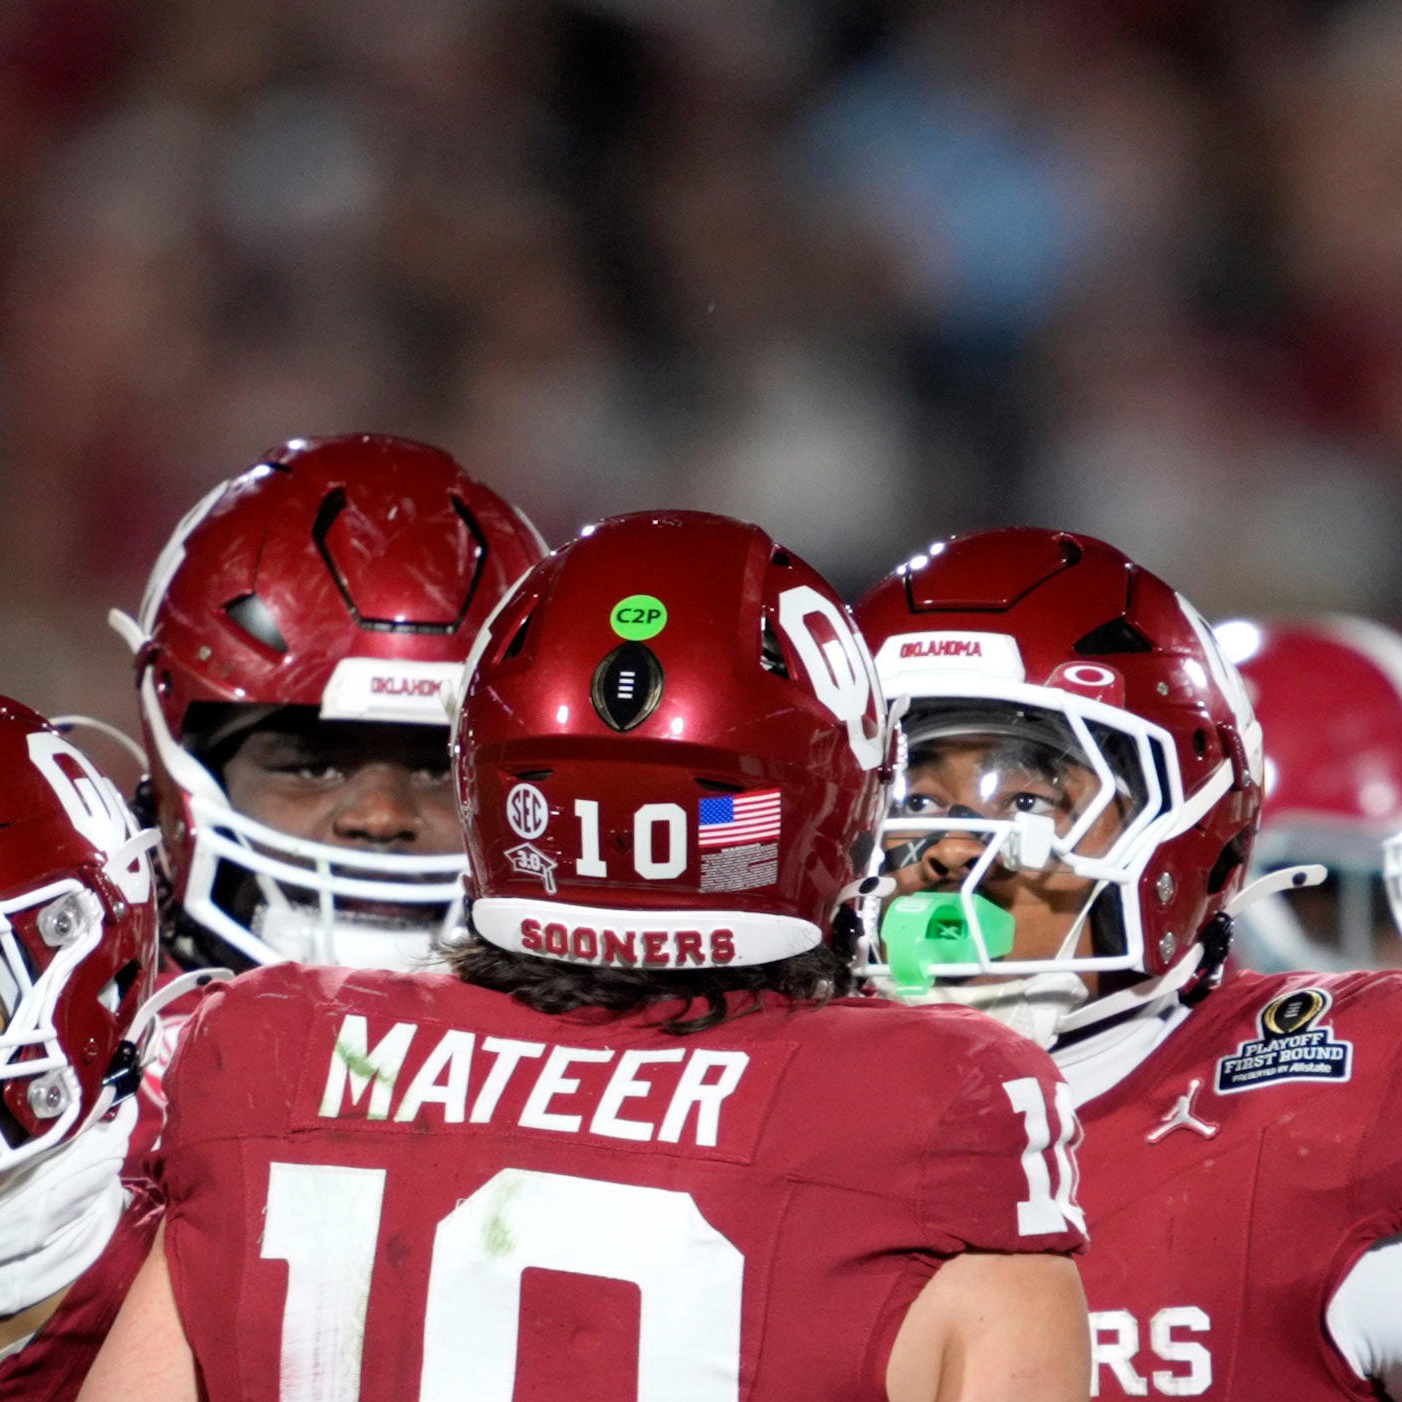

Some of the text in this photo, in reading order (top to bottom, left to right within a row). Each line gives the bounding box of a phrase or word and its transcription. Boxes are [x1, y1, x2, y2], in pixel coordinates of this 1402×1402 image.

[616, 606, 662, 626] C2P
[900, 640, 982, 658] OKLAHOMA
[512, 788, 544, 833] SEC
[574, 798, 688, 881] 10
[521, 918, 736, 965] SOONERS
[1244, 1033, 1324, 1056] PLAYOFF
[1224, 1047, 1344, 1074] FIRST ROUND
[1289, 1062, 1332, 1074] Allstate
[318, 1014, 750, 1147] MATEER
